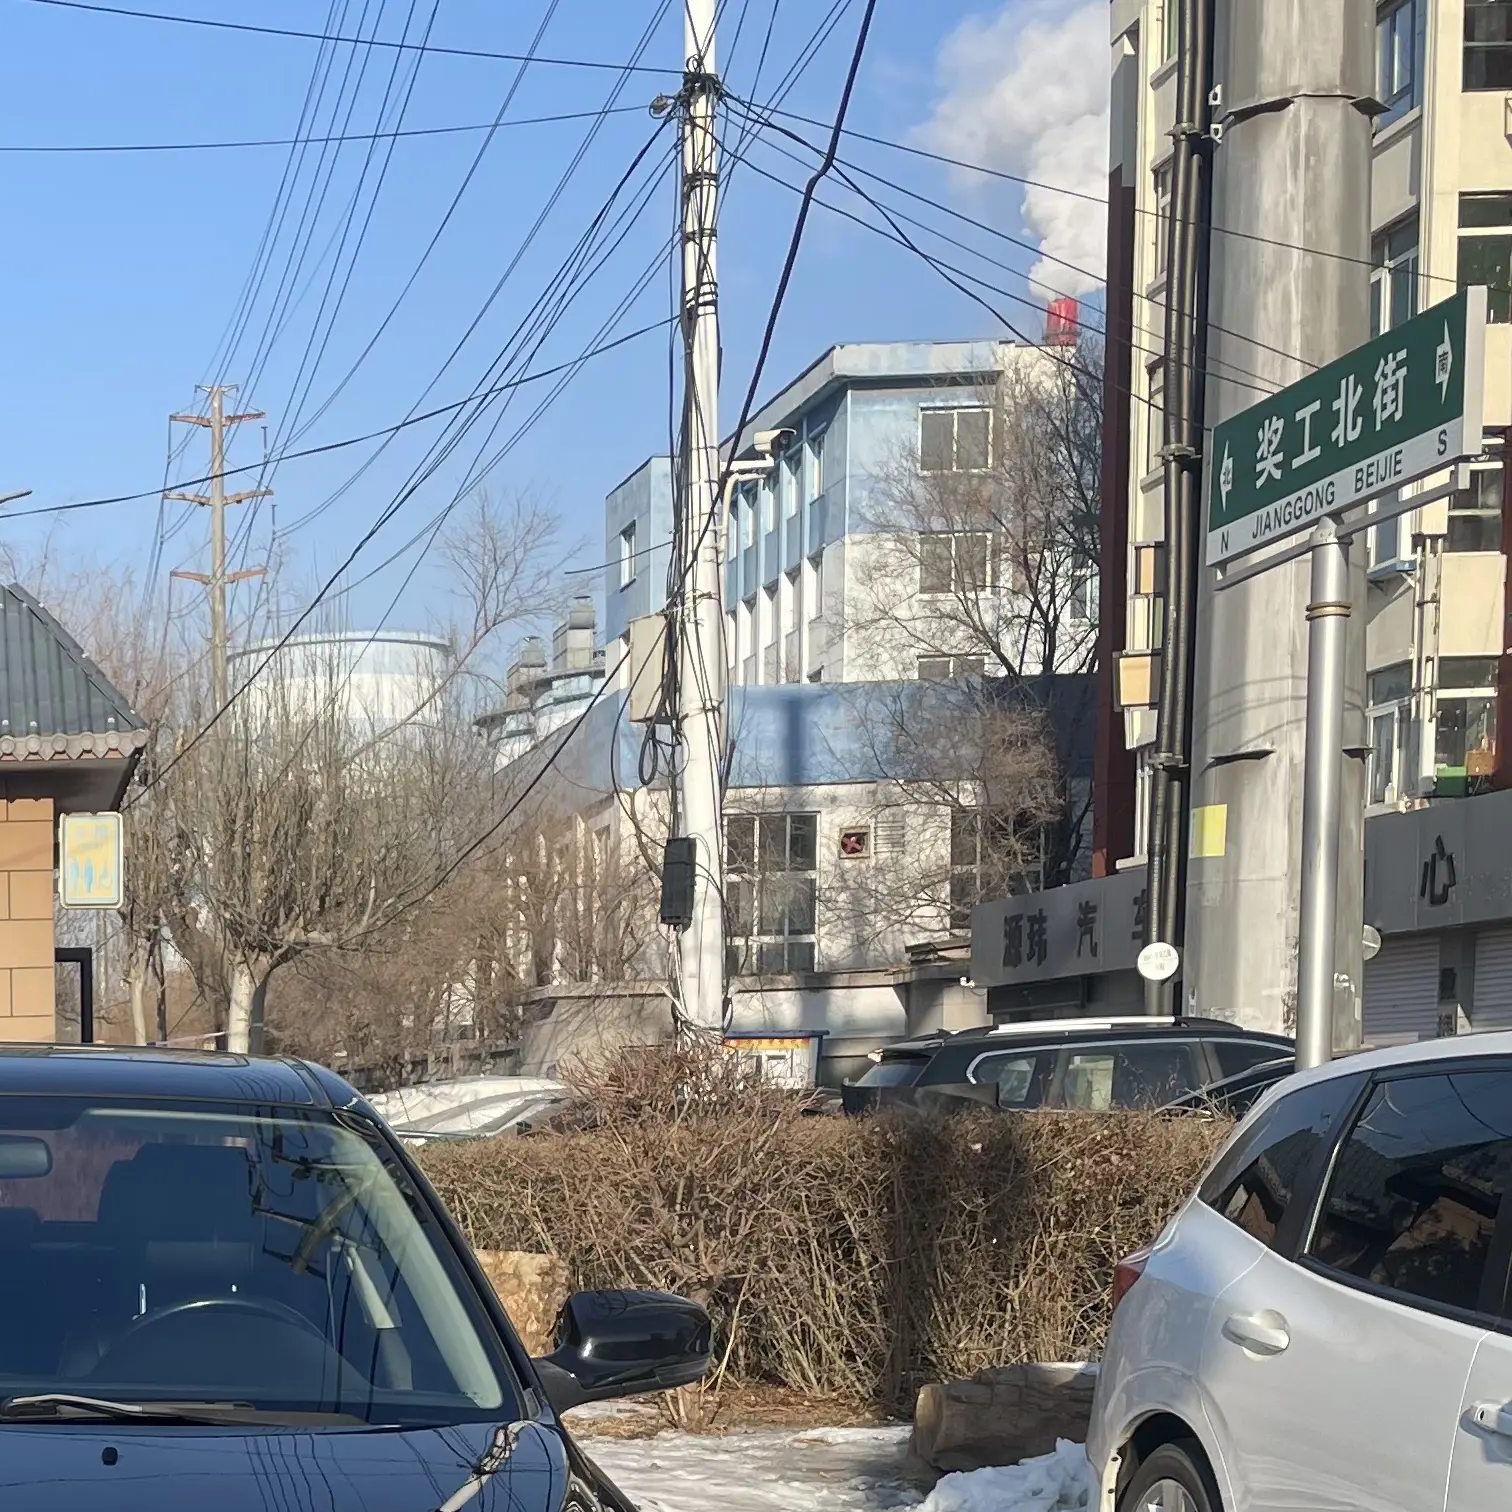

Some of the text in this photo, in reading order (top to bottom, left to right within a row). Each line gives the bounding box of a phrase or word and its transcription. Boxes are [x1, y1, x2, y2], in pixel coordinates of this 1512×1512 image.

[1255, 348, 1408, 490] 奖工北街
[1220, 429, 1448, 555] N JIANGGONG BEIJIE S
